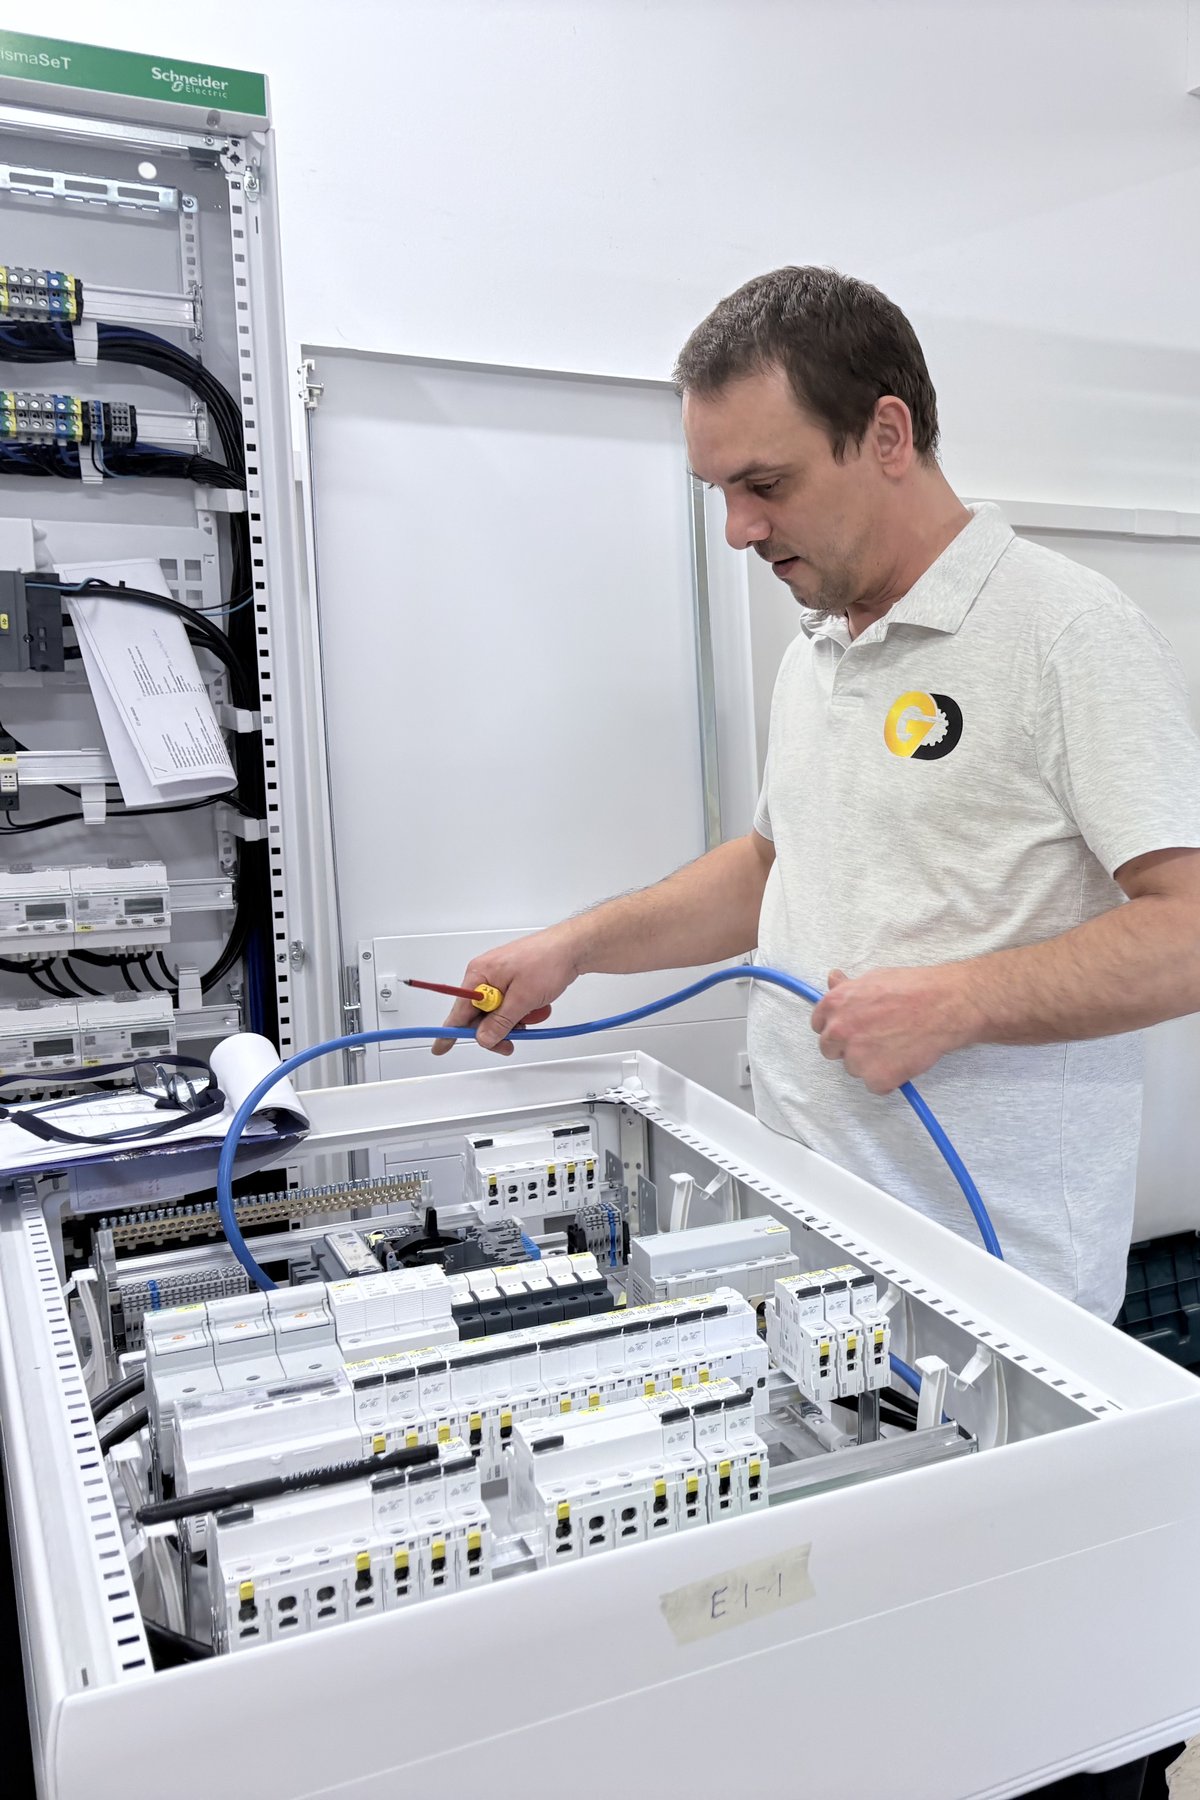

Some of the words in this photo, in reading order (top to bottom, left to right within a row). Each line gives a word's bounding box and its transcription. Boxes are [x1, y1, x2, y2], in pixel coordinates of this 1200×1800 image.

[0, 47, 72, 70] ismaSeT
[151, 66, 229, 91] Schneider
[185, 84, 228, 100] Electric
[711, 1572, 782, 1619] E1-1
